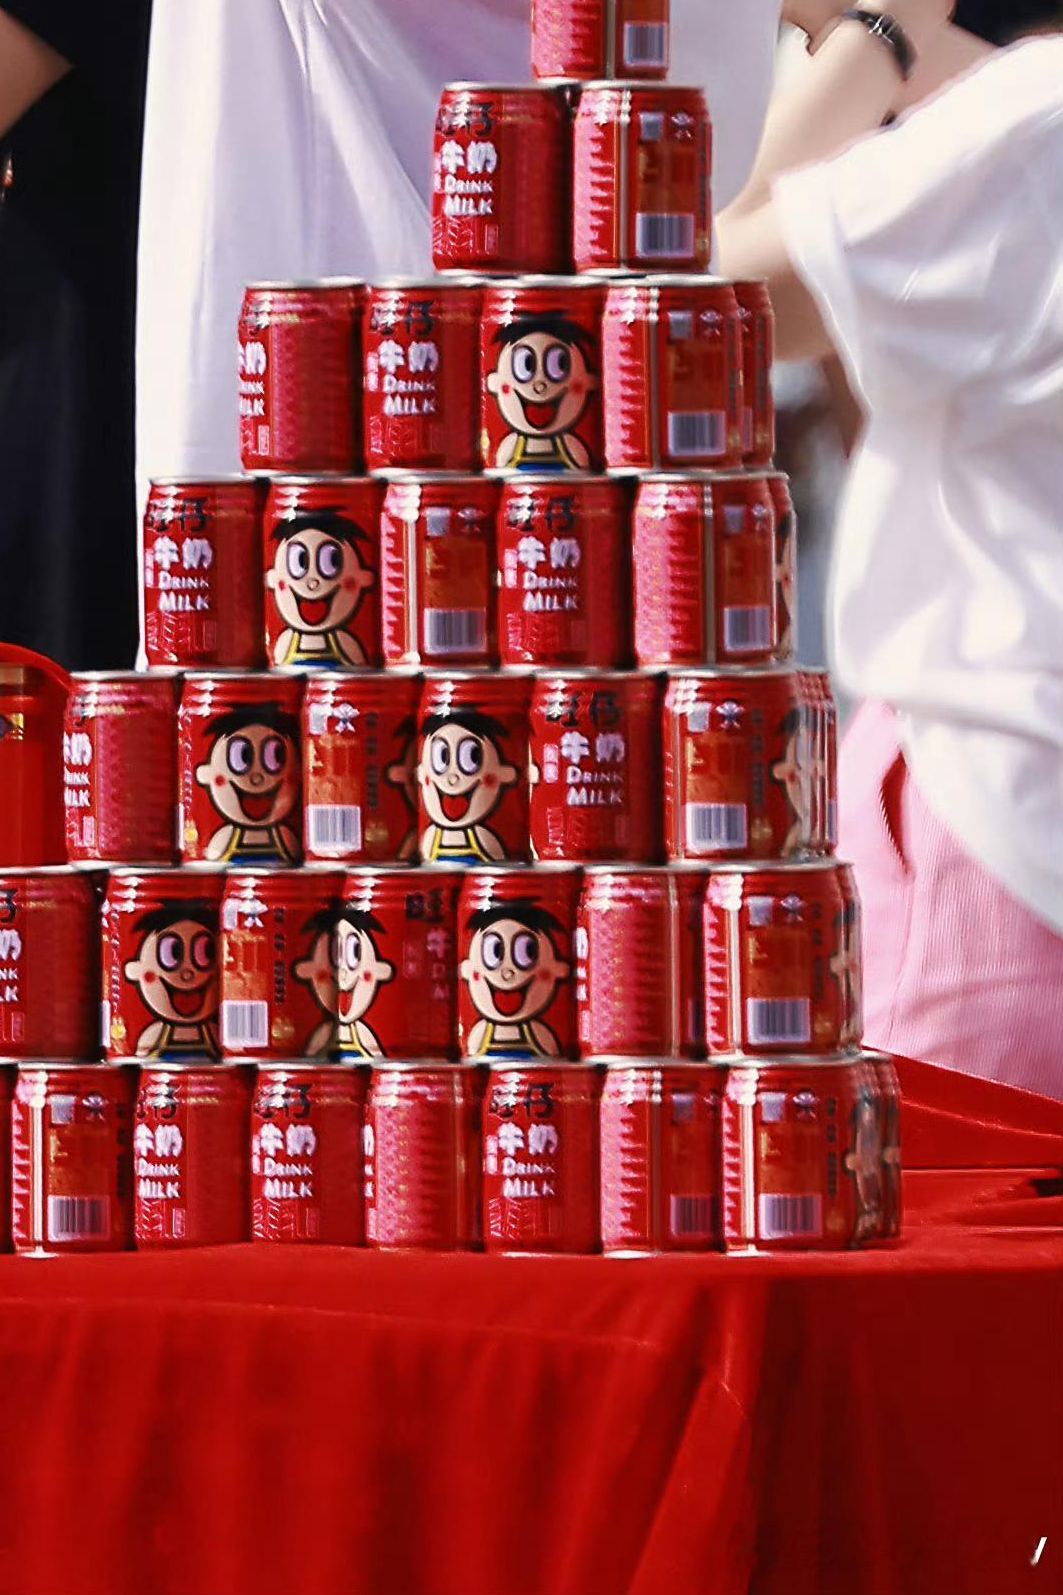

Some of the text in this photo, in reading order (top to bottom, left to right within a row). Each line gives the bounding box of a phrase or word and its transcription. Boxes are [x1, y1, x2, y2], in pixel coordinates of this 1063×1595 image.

[444, 174, 494, 194] DRINK
[443, 195, 493, 216] MILK
[383, 374, 436, 394] DRINK
[383, 395, 436, 417] MILK
[158, 571, 210, 591] DRINK
[523, 571, 578, 591] DRINK
[158, 591, 210, 613] MILK
[523, 591, 579, 613] MILK
[566, 765, 624, 785] DRINK
[566, 786, 624, 807] MILK
[263, 1157, 314, 1178] DRINK
[502, 1157, 556, 1177] DRINK
[137, 1178, 182, 1200] MILK
[263, 1178, 314, 1200] MILK
[502, 1177, 556, 1199] MILK
